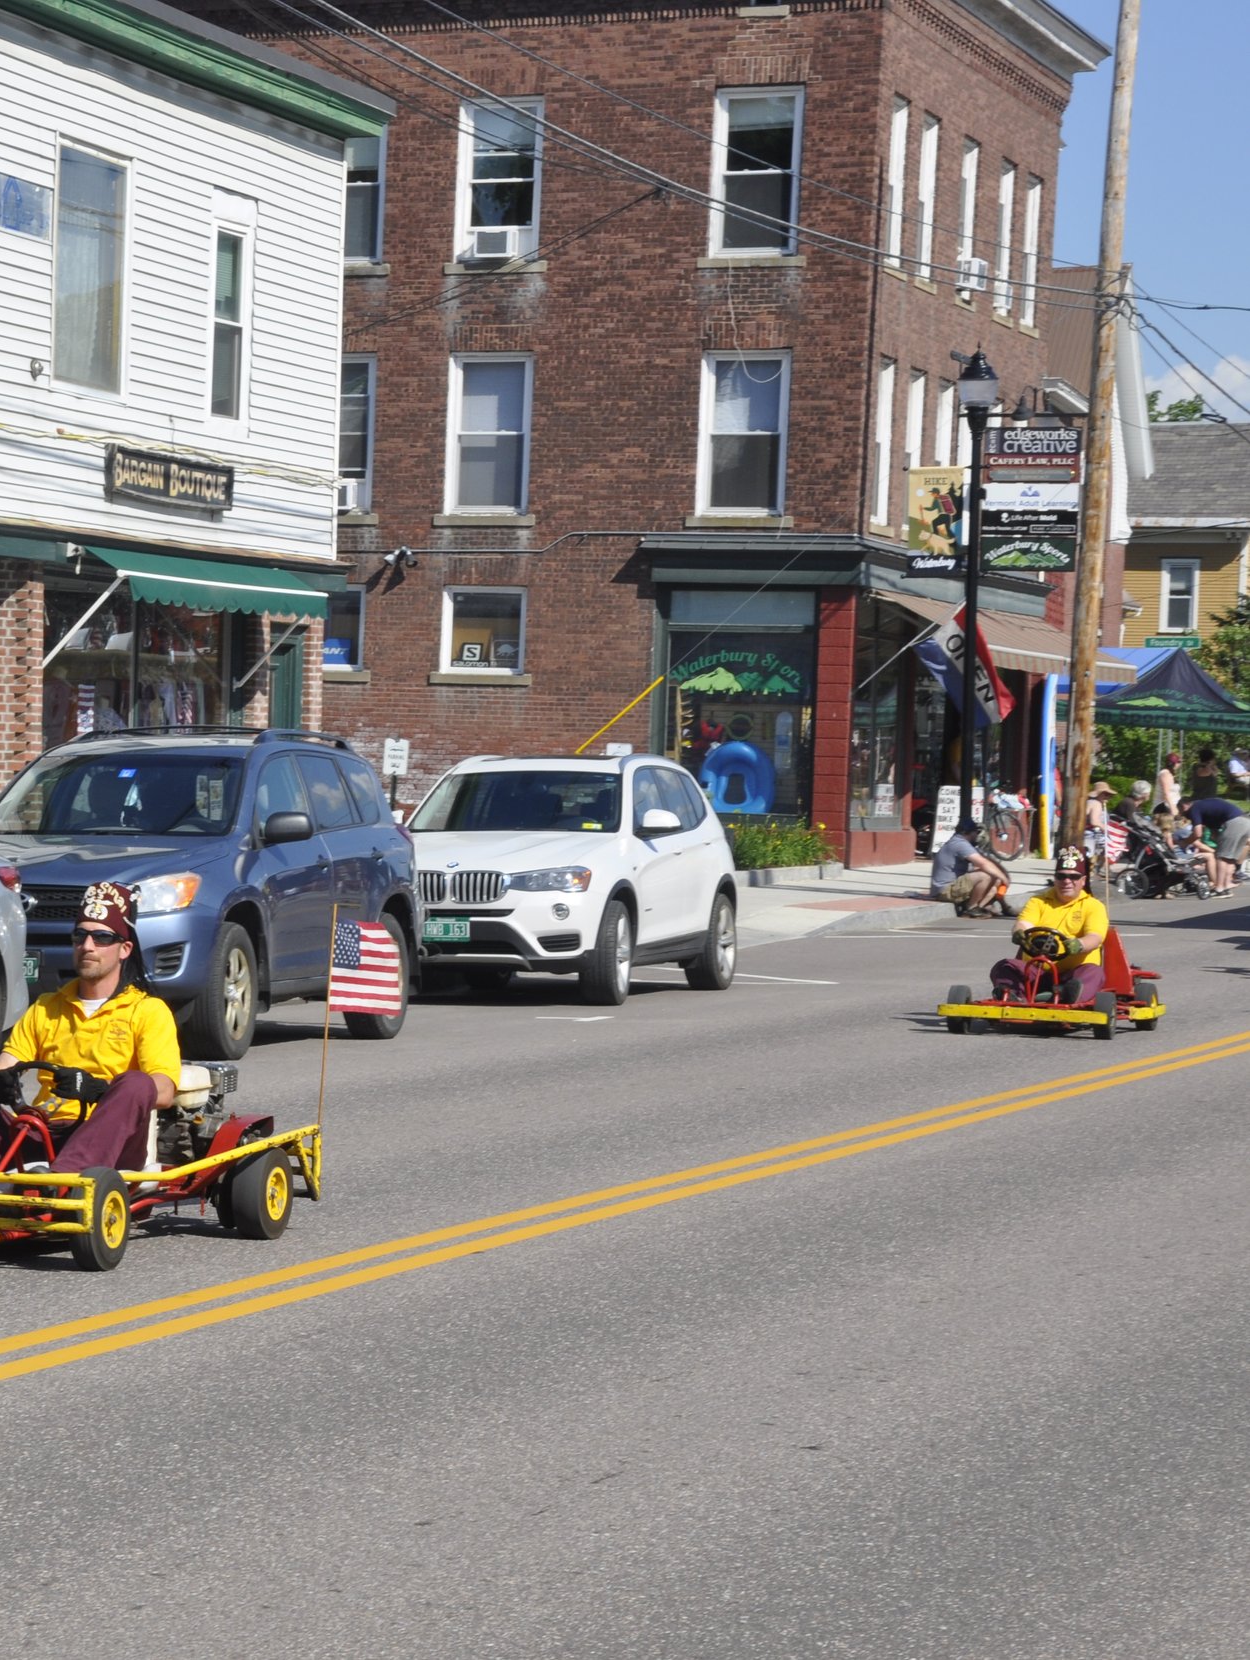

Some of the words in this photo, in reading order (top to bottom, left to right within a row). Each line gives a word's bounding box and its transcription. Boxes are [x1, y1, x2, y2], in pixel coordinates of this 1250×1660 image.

[1003, 427, 1078, 442] edgeworks
[1002, 440, 1077, 453] creative
[1051, 457, 1075, 465] PLLC
[114, 452, 165, 490] BARGAIN
[169, 462, 228, 501] BOUTIQUE
[923, 477, 949, 486] HIKE
[1019, 499, 1039, 507] Adult
[1041, 499, 1080, 509] Learning
[983, 540, 1040, 561] Waterbury
[1039, 541, 1071, 564] Sports
[1150, 639, 1184, 648] Foundry
[452, 660, 489, 668] salomon
[669, 649, 758, 682] Waterbury
[946, 633, 995, 704] OEN
[449, 923, 467, 937] 163
